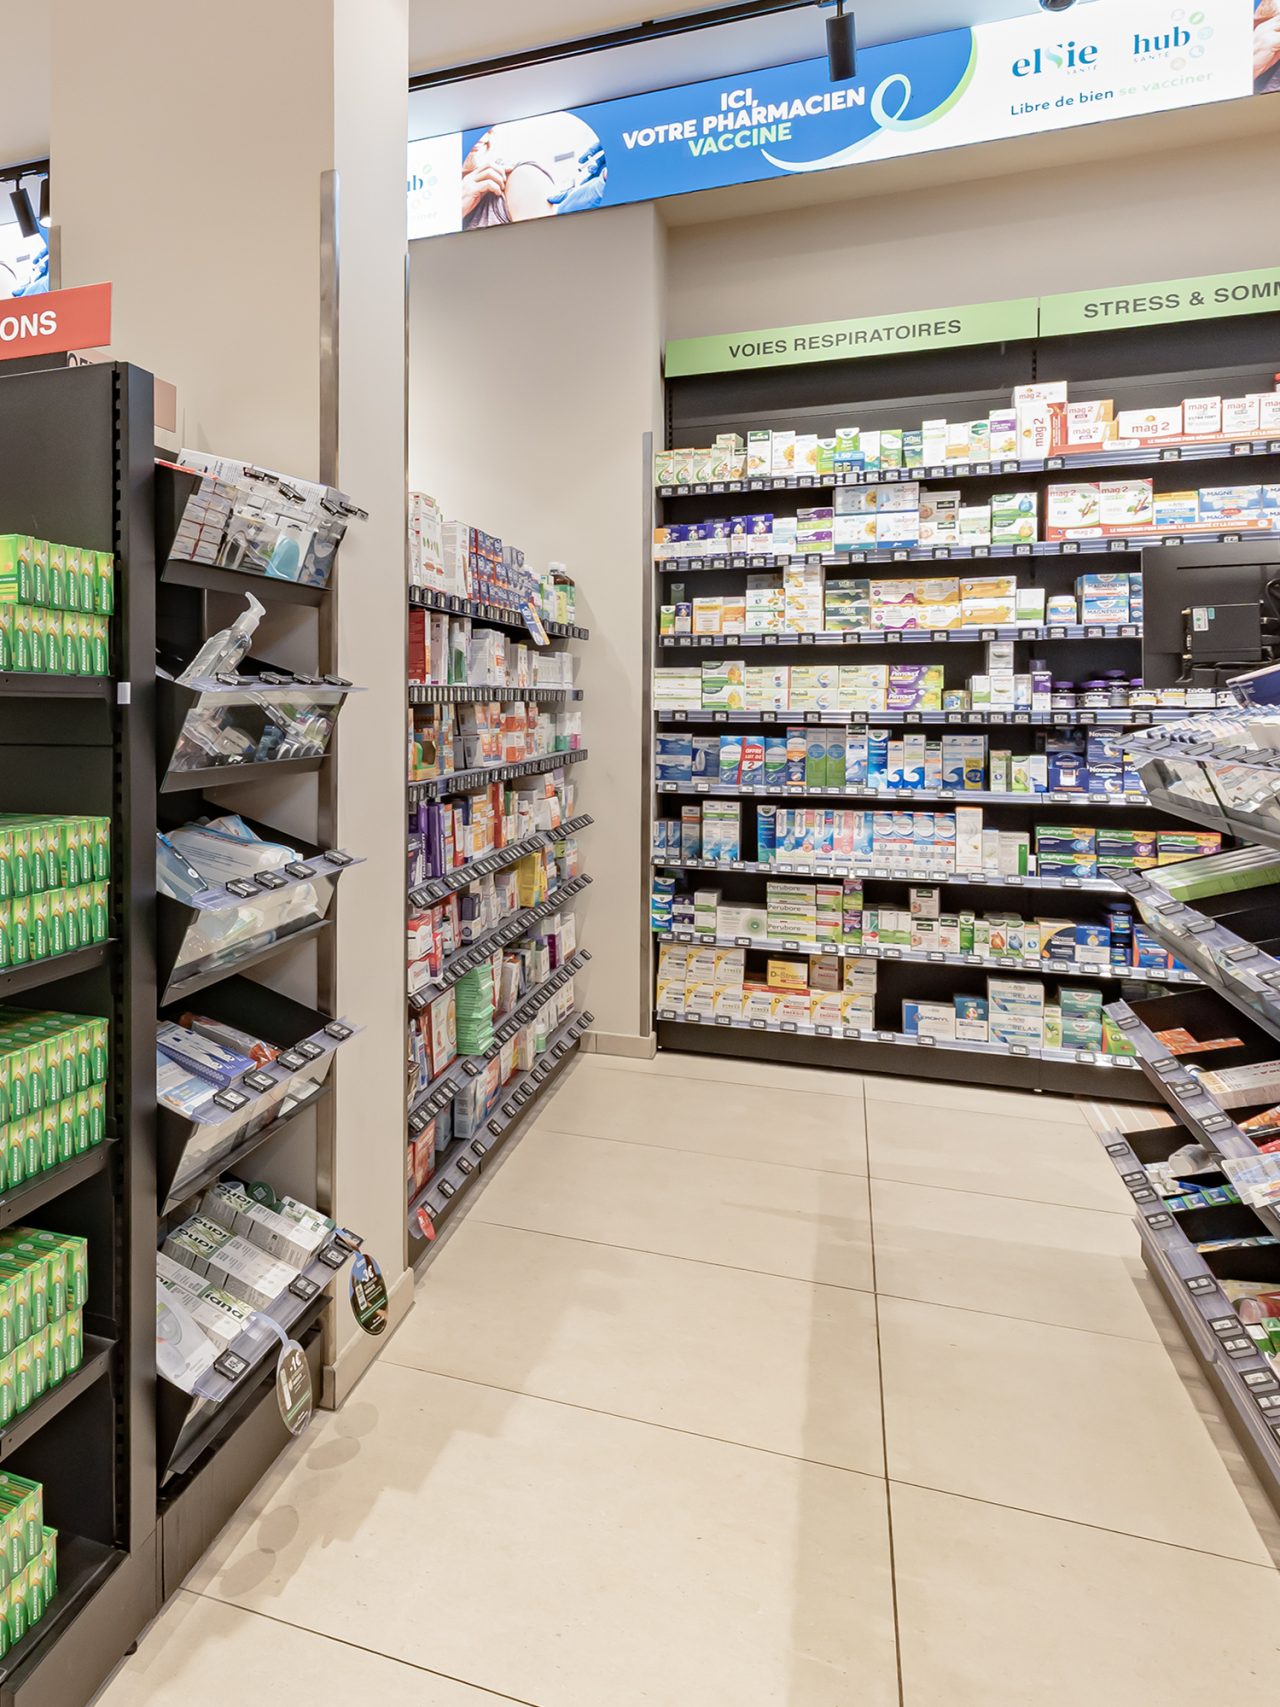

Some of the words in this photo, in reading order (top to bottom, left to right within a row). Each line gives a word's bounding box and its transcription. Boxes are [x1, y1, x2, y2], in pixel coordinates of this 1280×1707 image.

[1133, 25, 1192, 55] hub
[720, 88, 759, 111] ICI,
[1010, 101, 1050, 116] Libre
[1055, 96, 1074, 107] de
[1079, 88, 1114, 103] bien
[1118, 86, 1137, 97] se
[1142, 72, 1214, 93] vacciner
[622, 119, 697, 149] VOTRE
[702, 85, 866, 139] PHARMACIEN
[687, 124, 793, 157] VACCINE
[1083, 293, 1180, 319] STRESS
[1188, 290, 1205, 306] &
[728, 339, 788, 359] VOIES
[793, 319, 962, 352] RESPIRATOIRES
[1019, 392, 1034, 400] mag
[1188, 404, 1208, 412] mag
[1226, 403, 1246, 412] mag
[1035, 428, 1047, 447] mag
[1132, 424, 1158, 434] mag
[1161, 422, 1170, 430] 2
